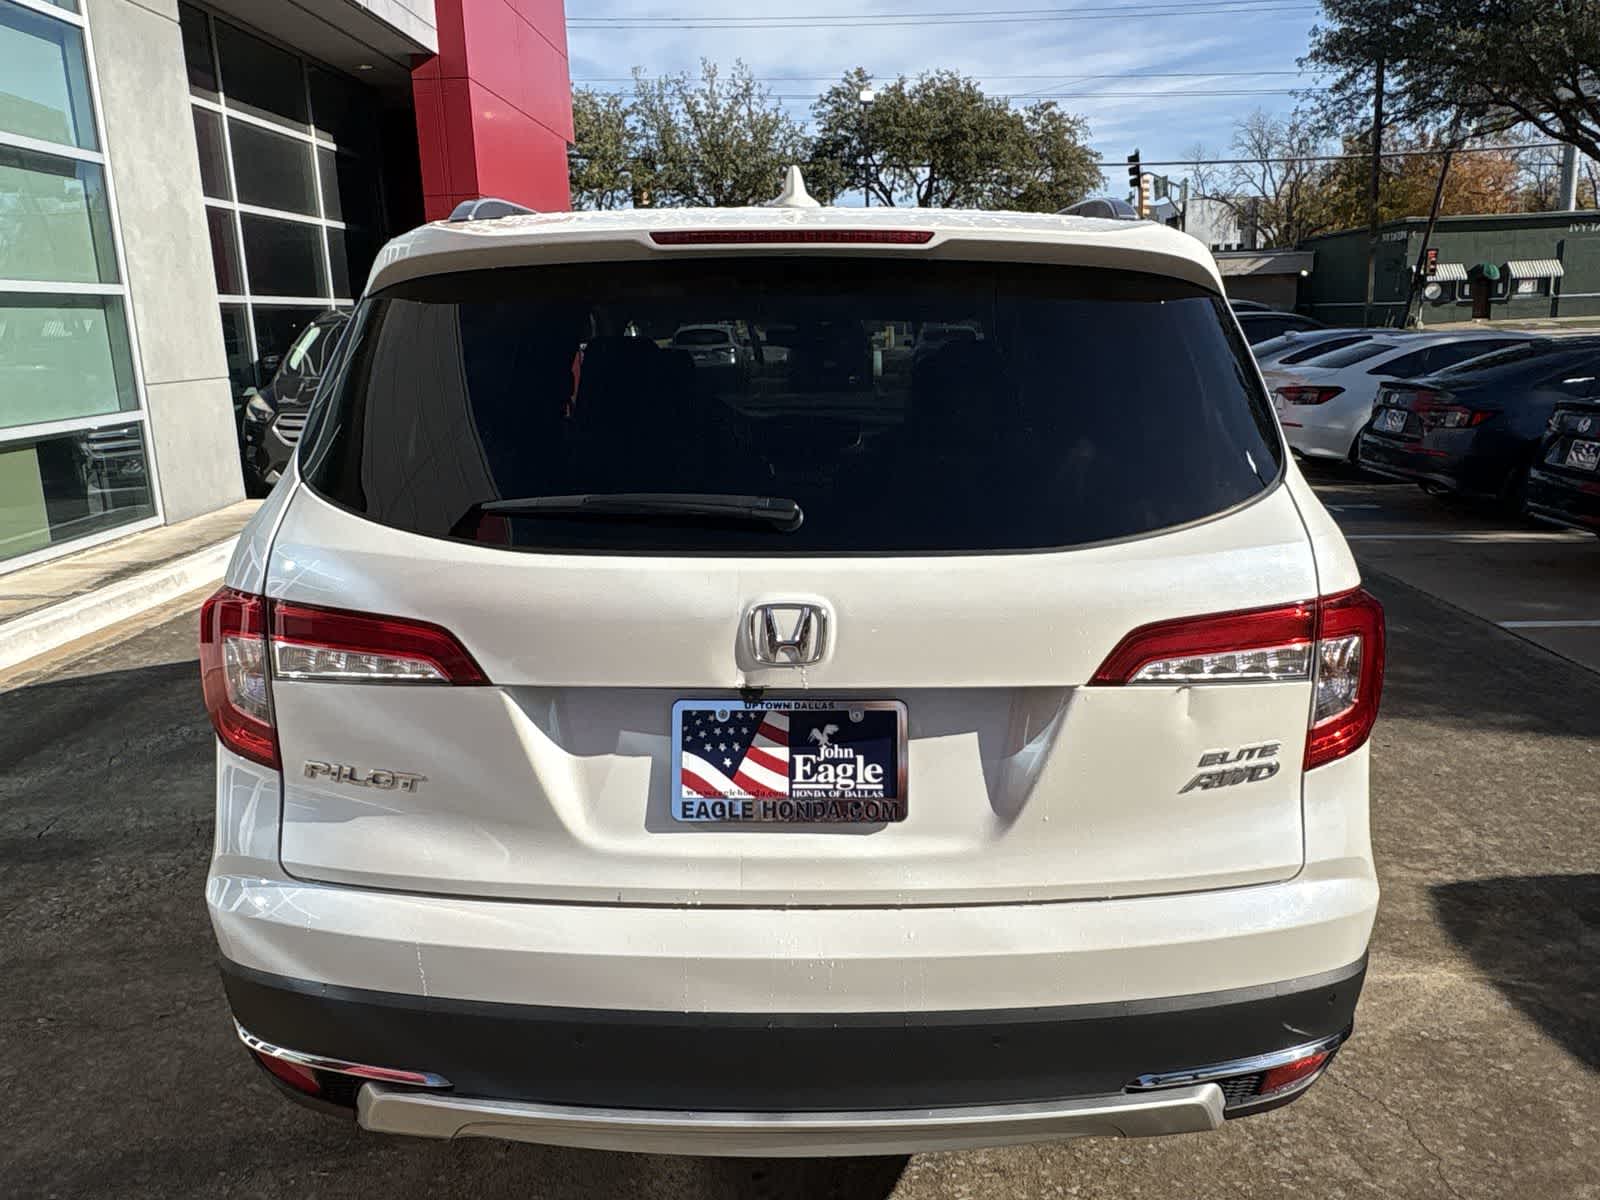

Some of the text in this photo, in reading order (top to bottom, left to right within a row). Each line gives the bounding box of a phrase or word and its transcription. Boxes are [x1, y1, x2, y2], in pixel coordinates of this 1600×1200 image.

[744, 701, 835, 710] UPTOWN DALLAS
[816, 743, 854, 761] John
[1197, 740, 1281, 768] ELITE
[303, 760, 428, 793] PILOT
[792, 754, 884, 790] Eagle
[1176, 759, 1281, 795] AWD
[792, 789, 885, 798] HONDA OF DALLAS
[681, 801, 898, 820] EAGLE HONDA.COM
